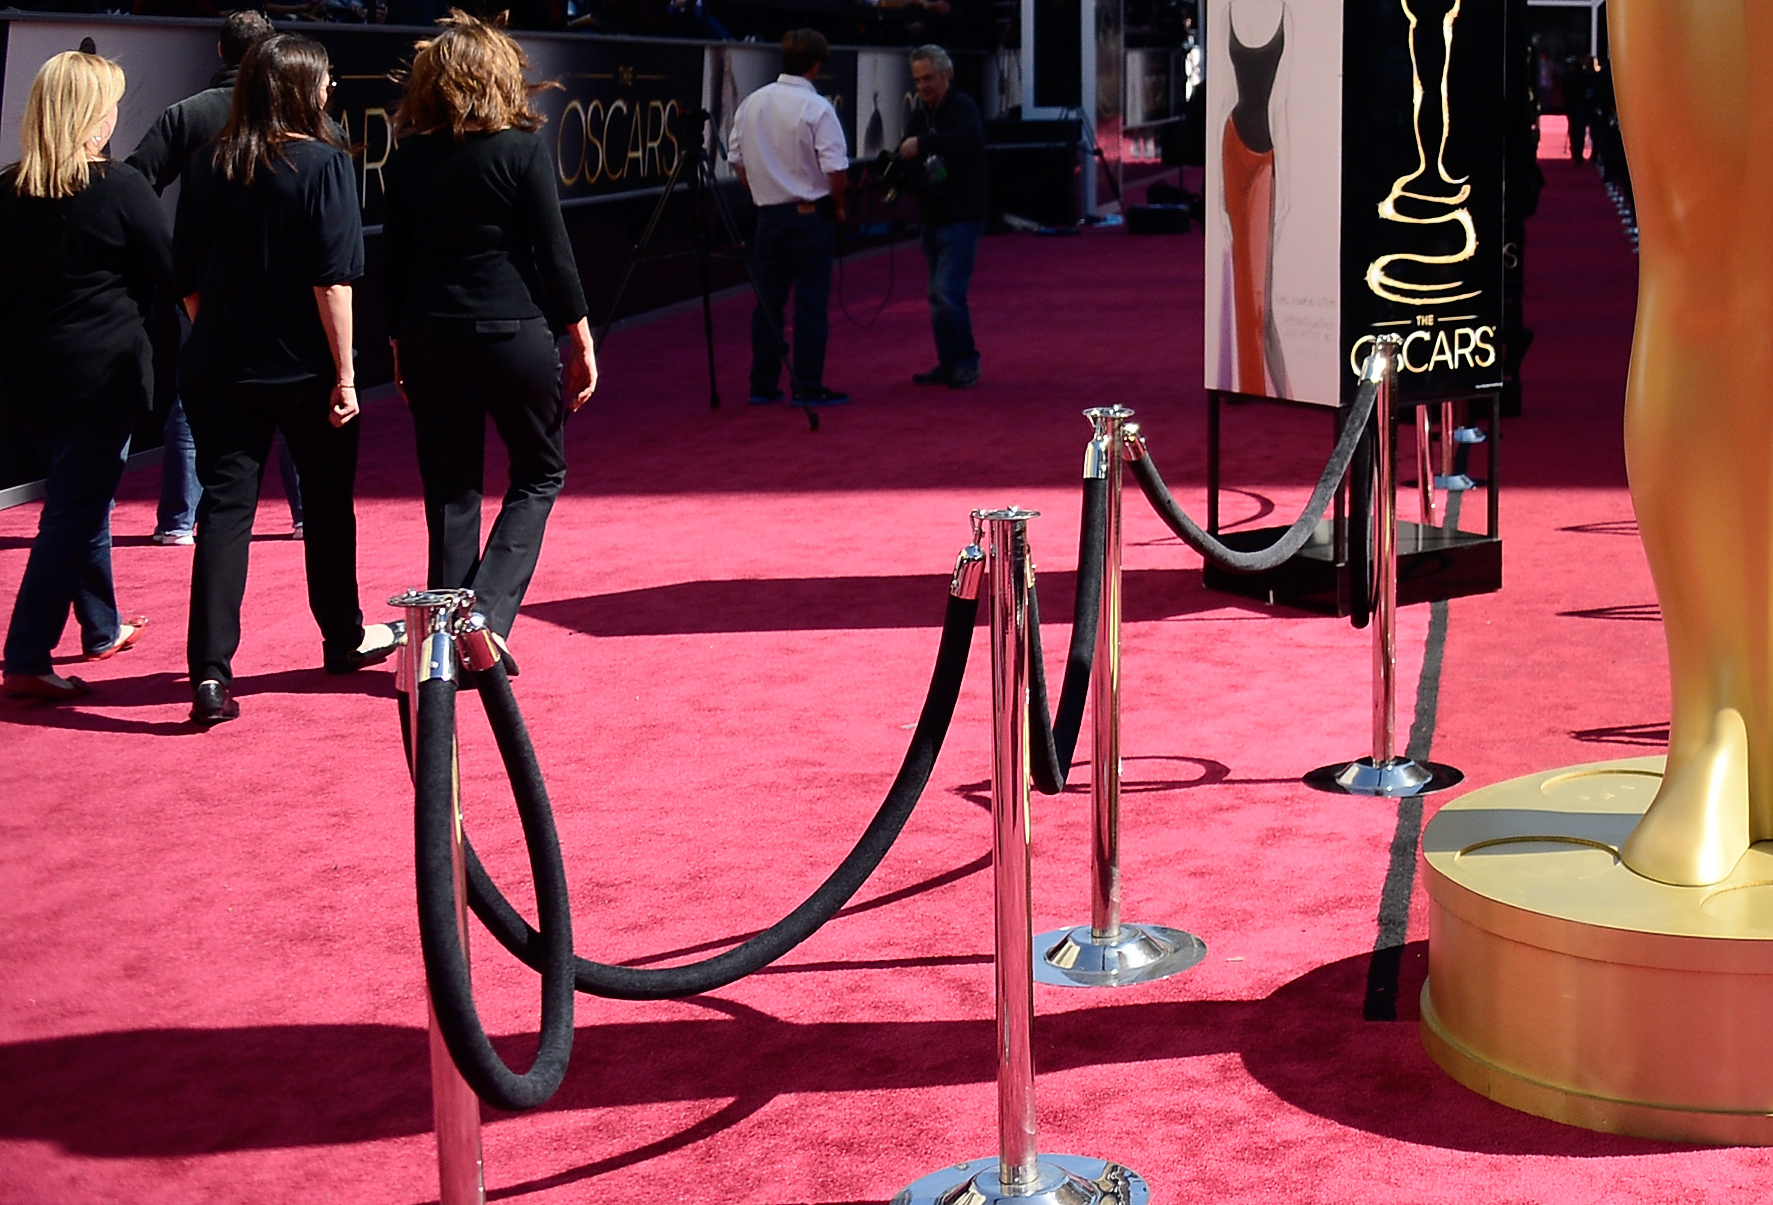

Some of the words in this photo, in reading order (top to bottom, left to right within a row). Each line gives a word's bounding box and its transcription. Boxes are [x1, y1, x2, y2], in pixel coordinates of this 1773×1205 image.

[557, 99, 680, 187] OSCARS
[1416, 314, 1434, 327] THE
[1351, 326, 1496, 376] OCARS
